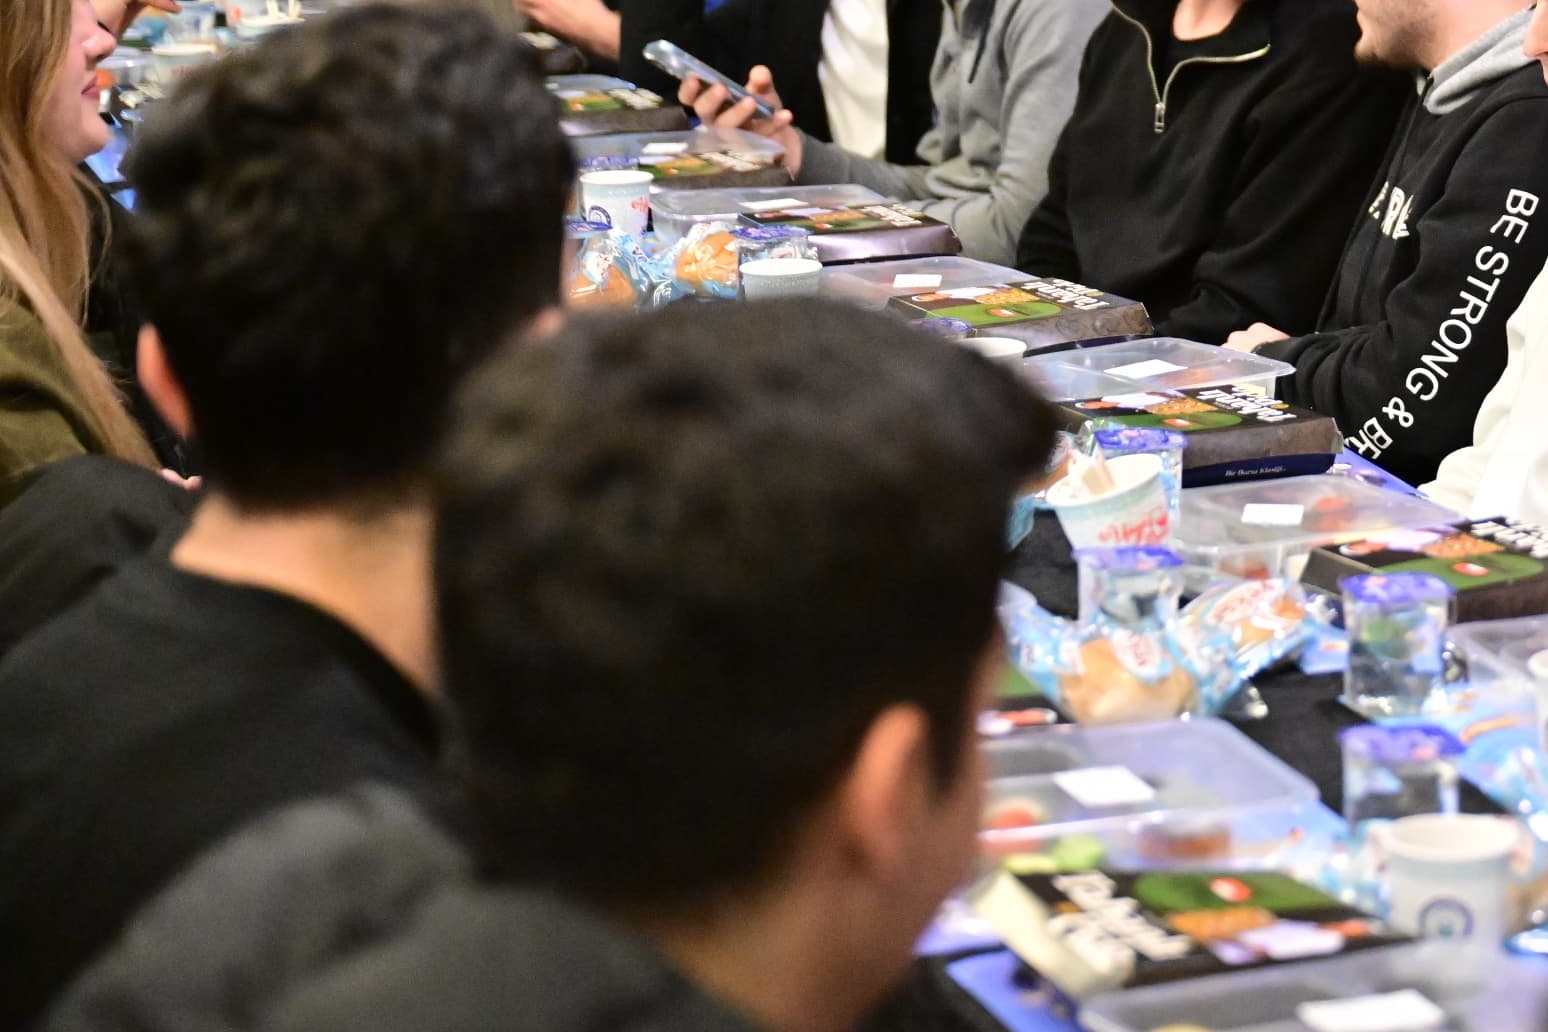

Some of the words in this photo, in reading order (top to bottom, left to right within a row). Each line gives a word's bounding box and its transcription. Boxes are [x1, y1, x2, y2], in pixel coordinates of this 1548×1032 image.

[1490, 188, 1540, 244] BE
[1405, 245, 1510, 402] STRONG
[1382, 396, 1414, 428] &
